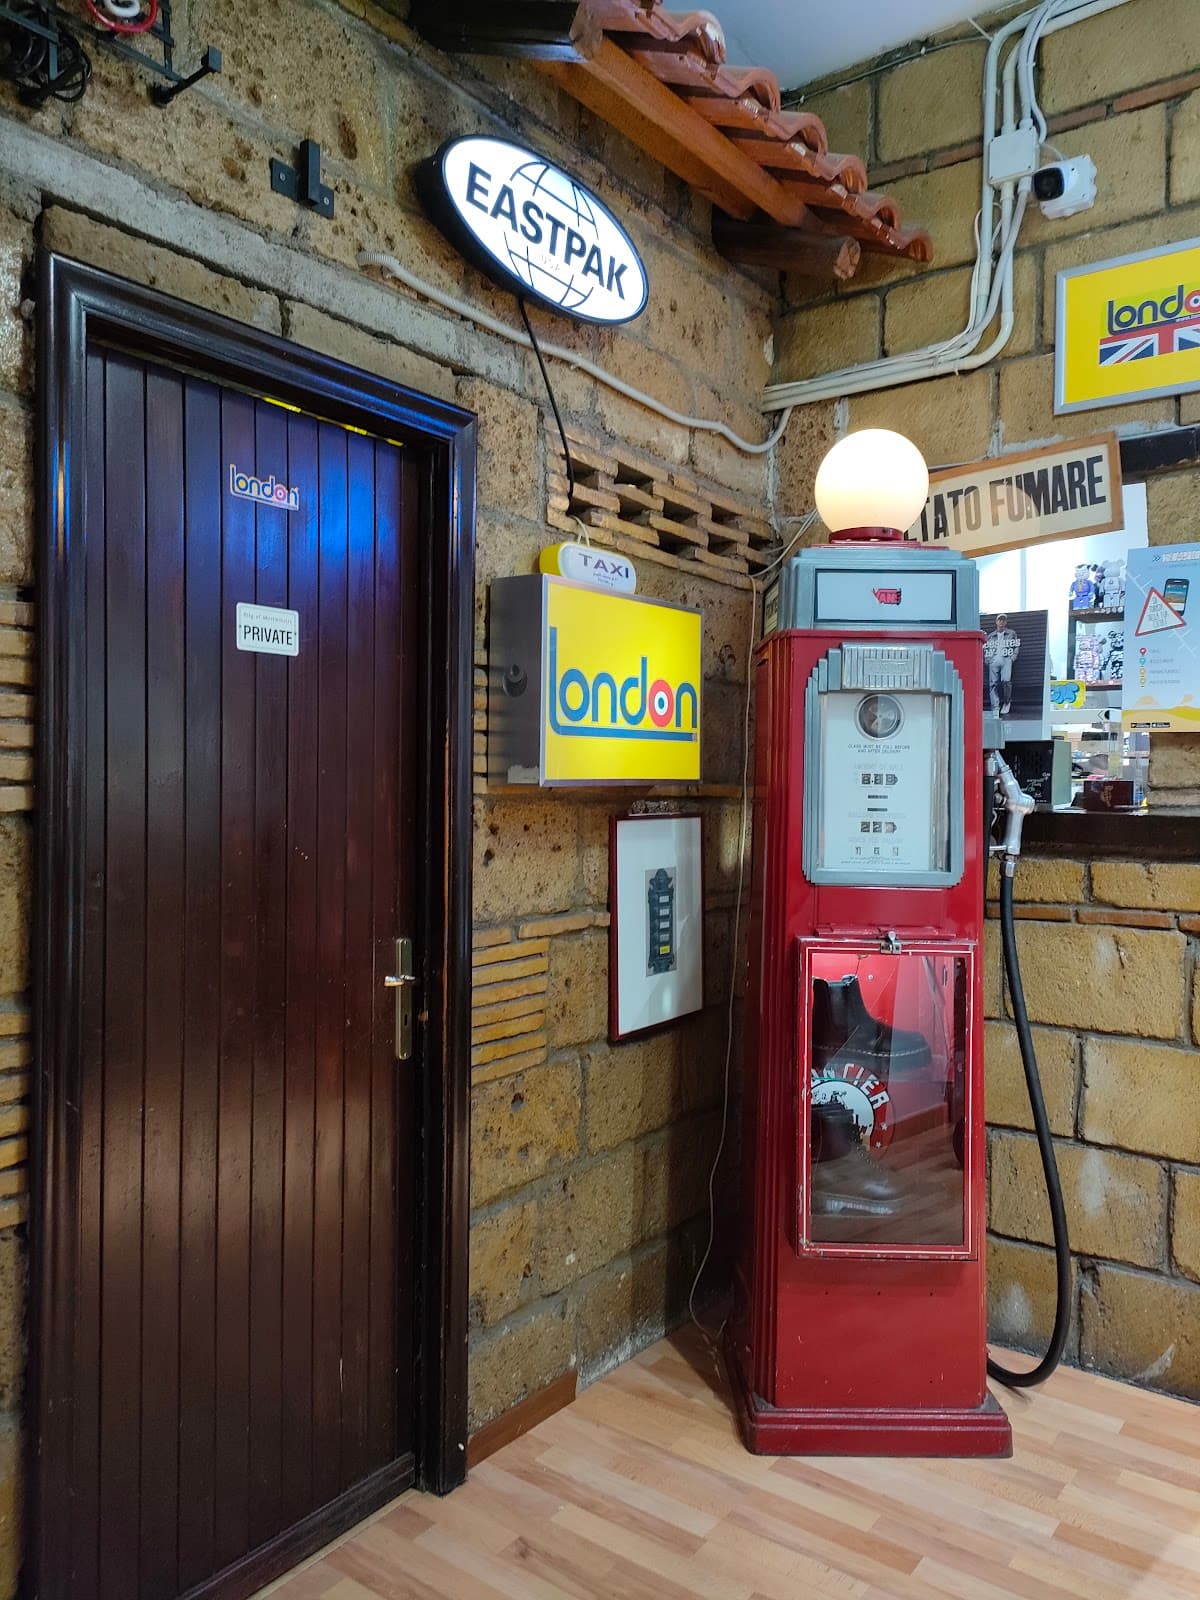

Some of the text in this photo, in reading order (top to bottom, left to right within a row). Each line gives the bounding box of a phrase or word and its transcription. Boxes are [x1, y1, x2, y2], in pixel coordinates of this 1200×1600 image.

[466, 161, 628, 300] EASTPAK
[1107, 284, 1200, 336] londo
[230, 464, 299, 510] london
[903, 454, 1107, 543] TATO FUMARE
[578, 552, 629, 579] TAXI
[243, 625, 293, 646] PRIVATE
[549, 626, 698, 742] london
